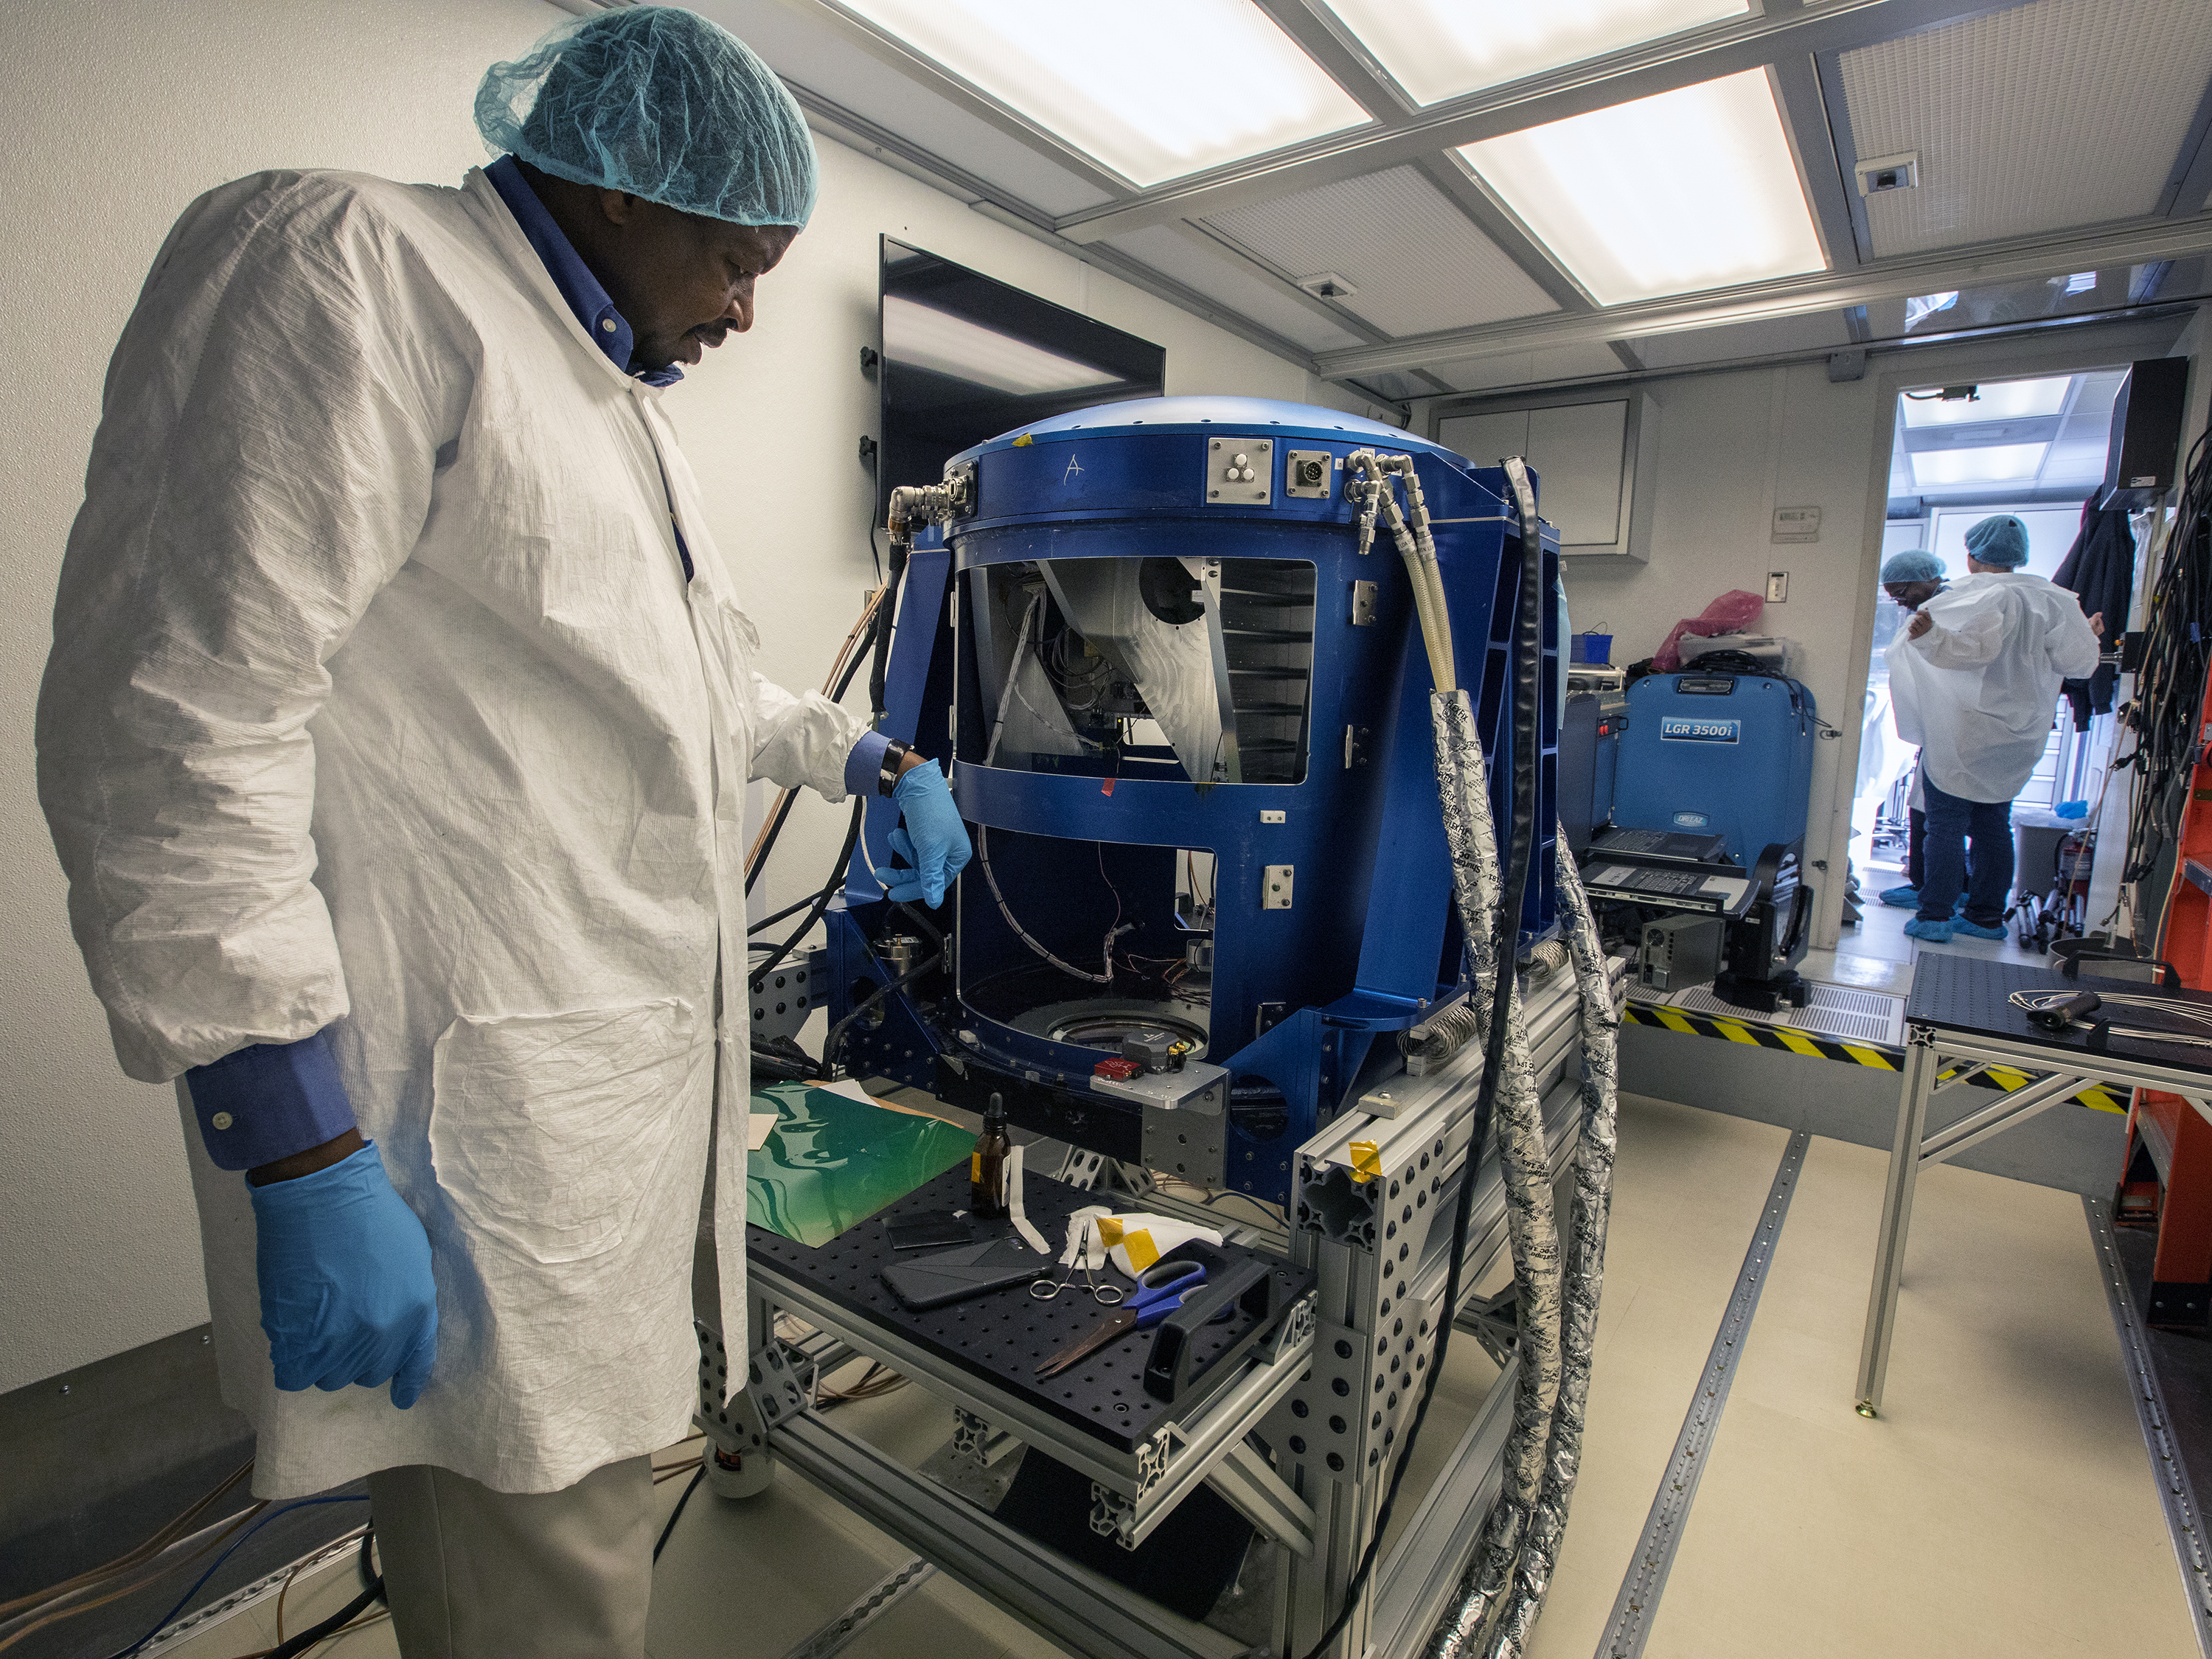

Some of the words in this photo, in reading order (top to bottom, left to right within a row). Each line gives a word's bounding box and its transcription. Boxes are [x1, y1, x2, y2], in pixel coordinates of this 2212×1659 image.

[1063, 453, 1085, 486] A
[1665, 724, 1690, 734] LGR
[1692, 726, 1733, 736] 3500i
